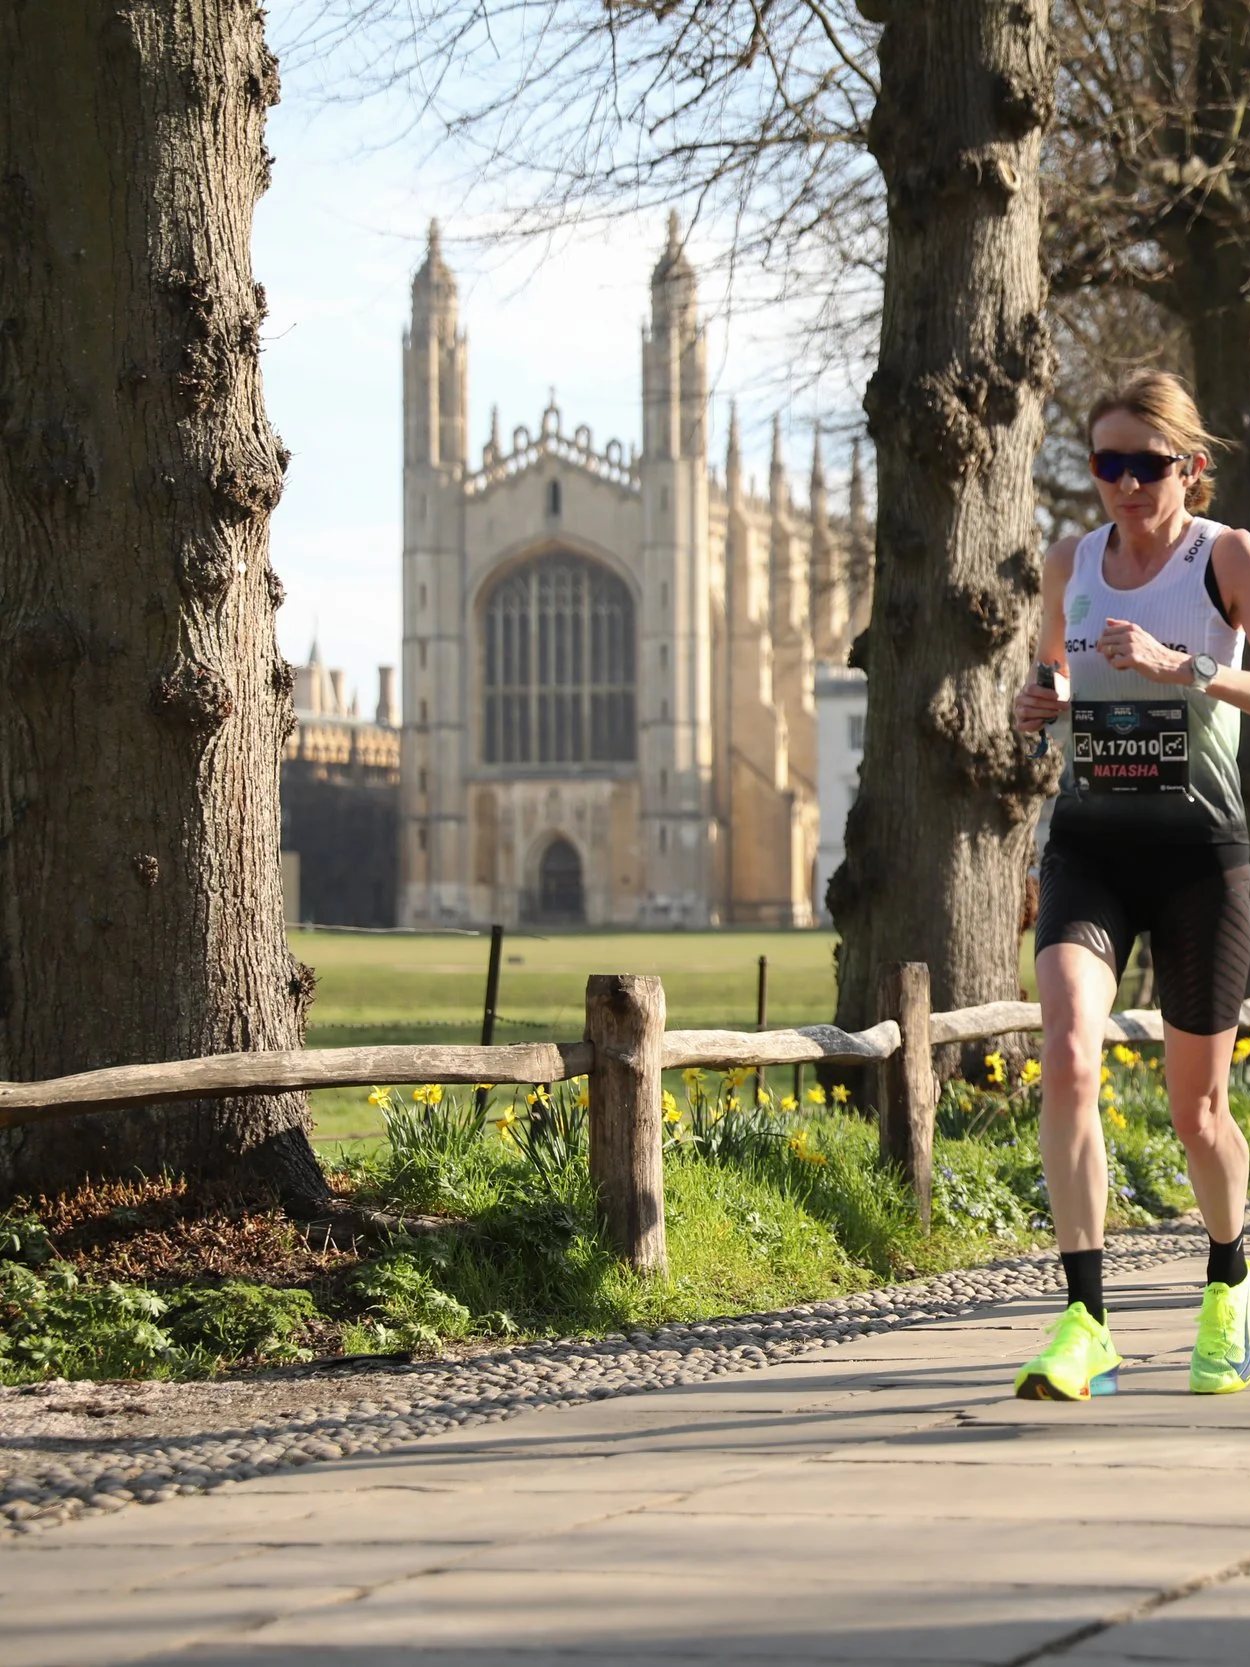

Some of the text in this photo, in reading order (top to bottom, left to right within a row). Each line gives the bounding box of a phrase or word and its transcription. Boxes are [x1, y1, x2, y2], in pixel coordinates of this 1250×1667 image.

[1184, 533, 1206, 563] soar
[1092, 739, 1160, 756] V.17010
[1093, 764, 1159, 777] NATASHA
